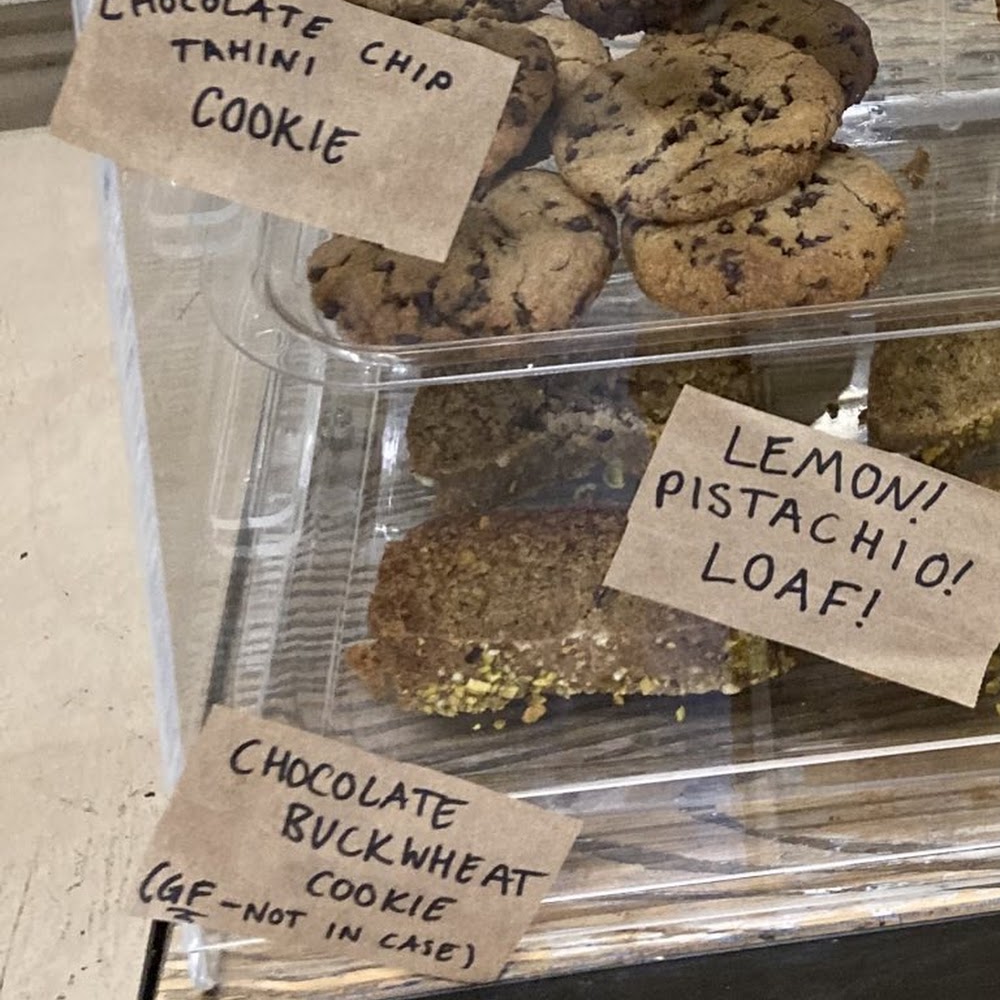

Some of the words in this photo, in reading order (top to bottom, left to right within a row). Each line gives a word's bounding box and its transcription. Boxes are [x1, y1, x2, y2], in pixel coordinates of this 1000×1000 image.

[170, 38, 316, 77] TAHINI
[360, 41, 454, 91] CHIP
[191, 86, 360, 164] COOKIE
[724, 425, 948, 525] LEMON!
[655, 469, 974, 597] PISTACHIO!
[701, 542, 883, 629] LOAF!
[229, 739, 469, 830] CHOCOLATE
[281, 803, 550, 897] BUCKWHEAT
[306, 870, 458, 922] COOKIE
[325, 922, 361, 942] IN
[379, 932, 476, 970] CASE)
